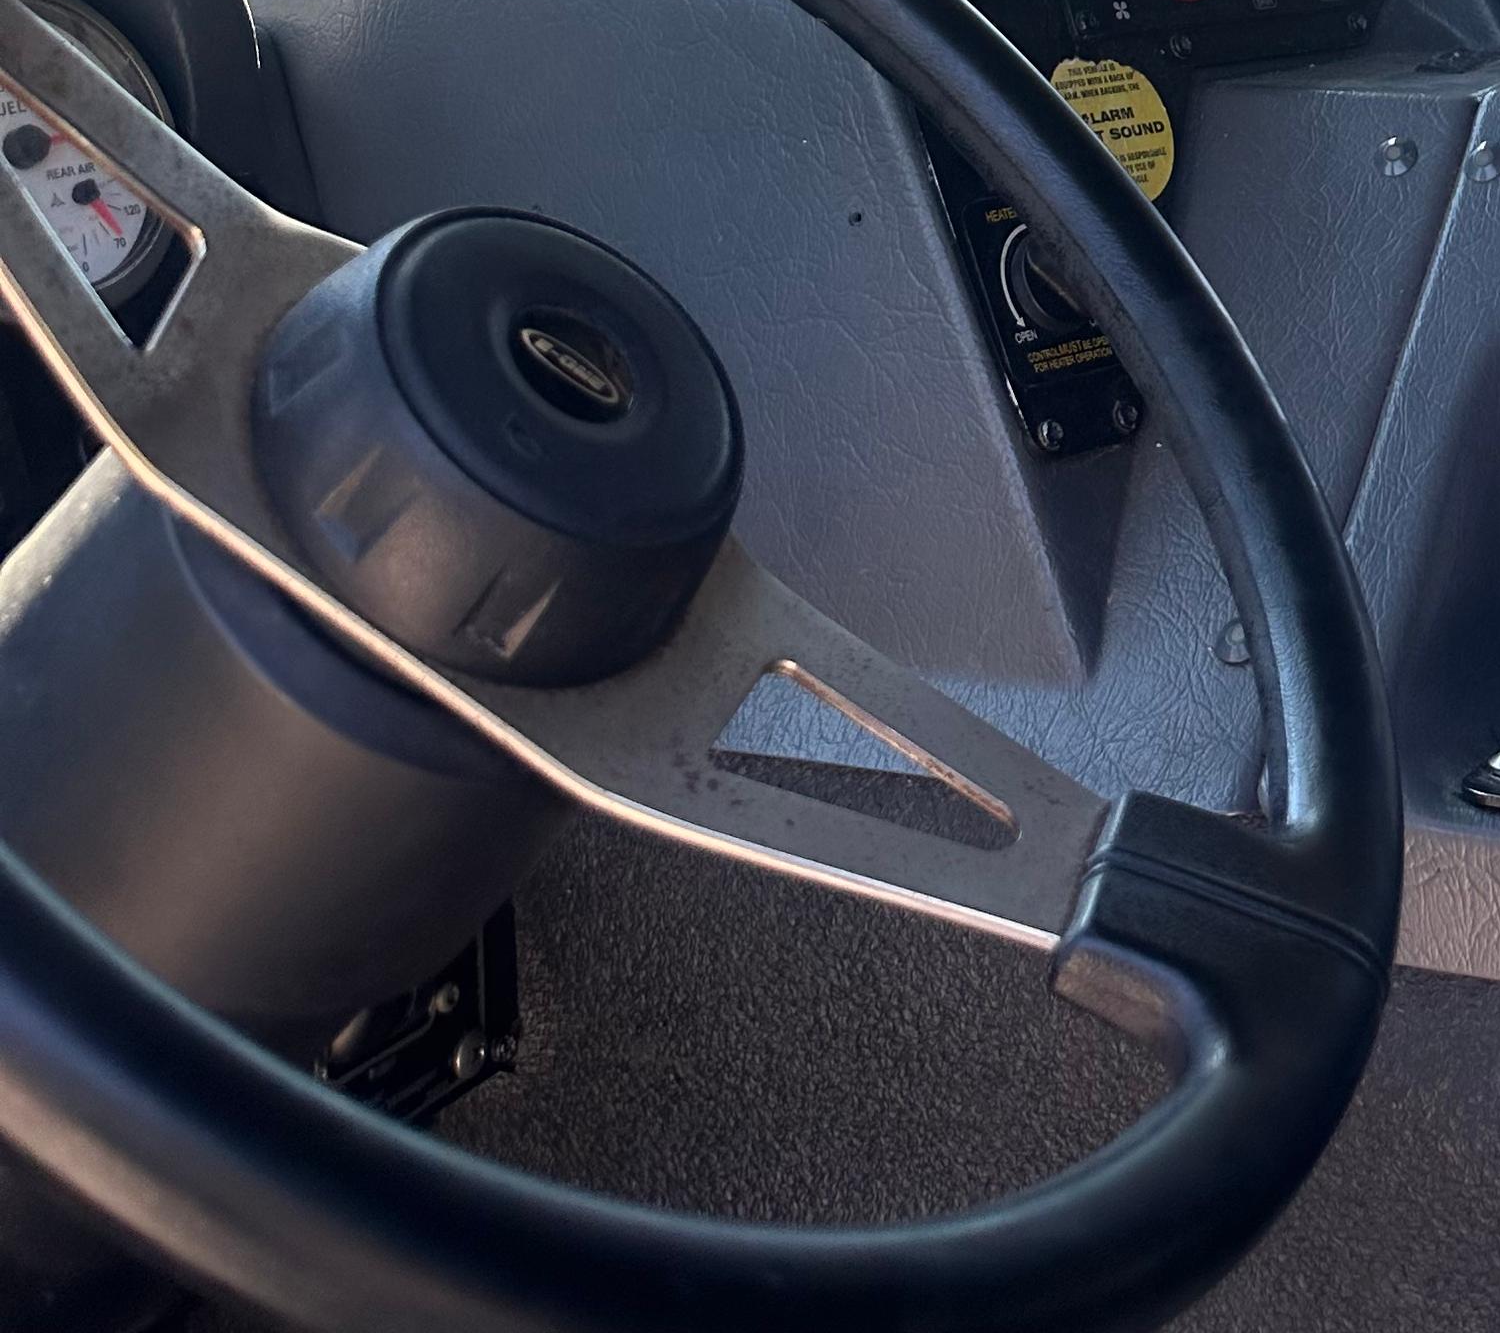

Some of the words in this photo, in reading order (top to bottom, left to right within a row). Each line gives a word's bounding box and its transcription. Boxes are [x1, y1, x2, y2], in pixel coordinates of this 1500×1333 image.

[1108, 121, 1165, 140] SOUND
[47, 164, 76, 181] REAR
[78, 161, 96, 176] AIR
[123, 203, 142, 216] 120
[985, 206, 1017, 223] HEATE
[114, 237, 127, 249] 70
[82, 261, 90, 273] 0
[1015, 329, 1039, 344] OPEN
